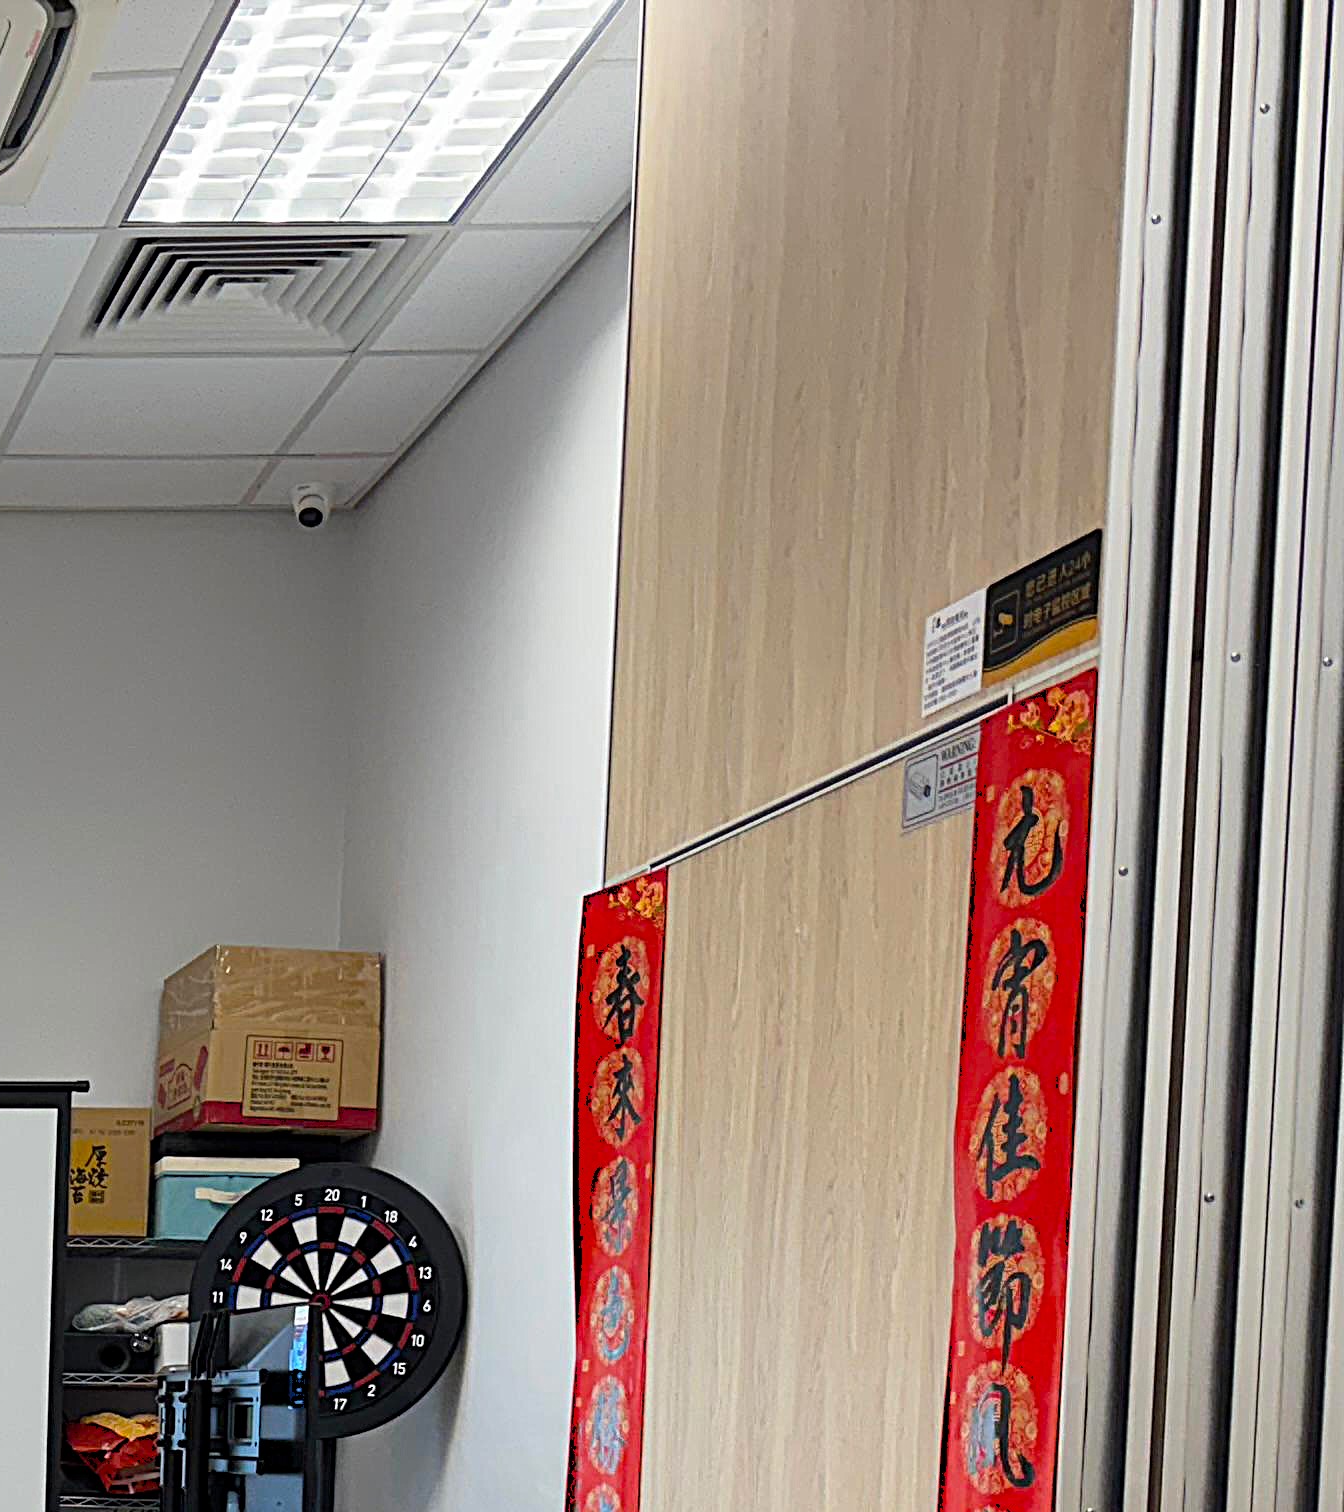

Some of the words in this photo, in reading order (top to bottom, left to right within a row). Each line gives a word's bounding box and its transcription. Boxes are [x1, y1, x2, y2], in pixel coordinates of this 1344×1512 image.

[294, 1194, 303, 1206] 5
[324, 1189, 340, 1201] 20
[361, 1196, 367, 1208] 1
[260, 1209, 274, 1221] 12
[384, 1210, 398, 1223] 18
[239, 1232, 248, 1244] 9
[408, 1236, 418, 1248] 4
[220, 1259, 232, 1271] 14
[418, 1267, 432, 1280] 13
[212, 1291, 223, 1303] 11
[423, 1300, 432, 1312] 6
[411, 1334, 424, 1347] 10
[393, 1363, 406, 1375] 15
[367, 1385, 376, 1397] 2
[333, 1398, 347, 1411] 17
